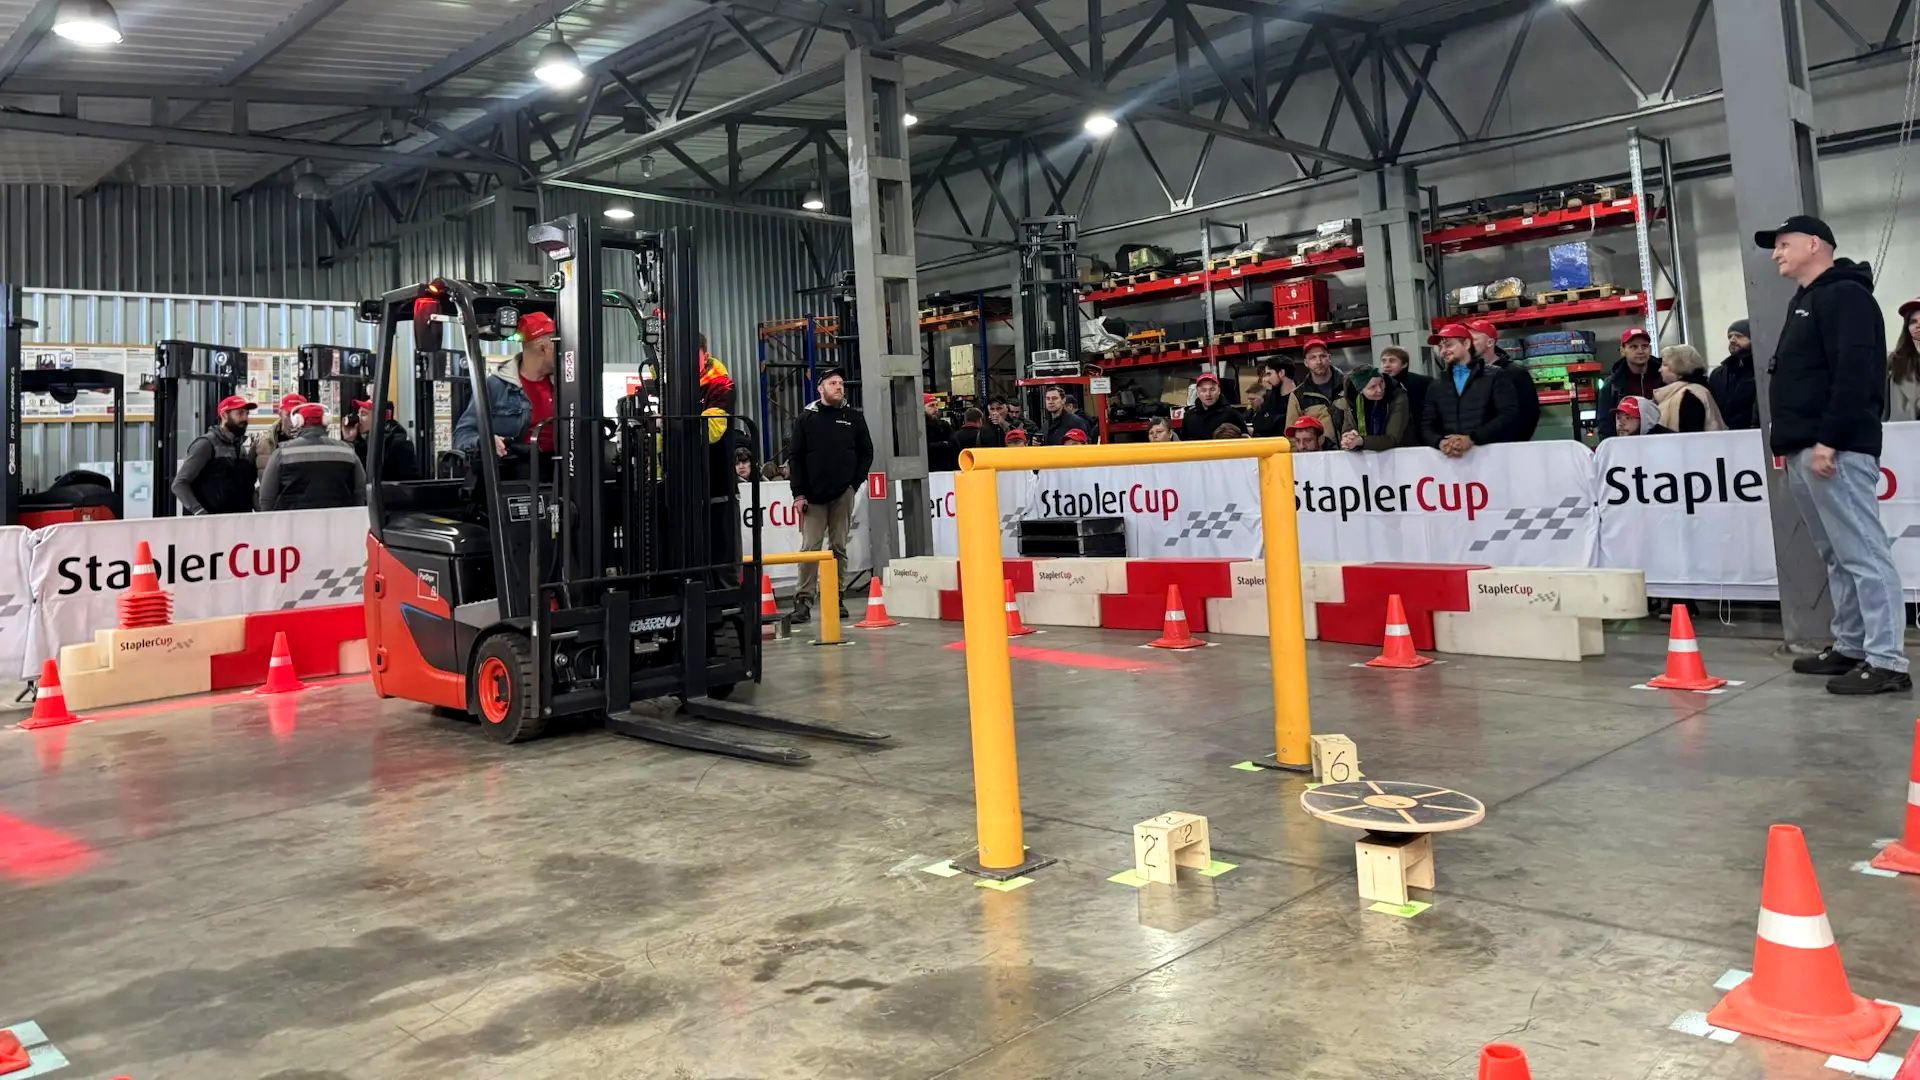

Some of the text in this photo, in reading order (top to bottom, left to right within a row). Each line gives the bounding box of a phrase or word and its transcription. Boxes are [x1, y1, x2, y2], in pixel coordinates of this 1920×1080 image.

[1041, 482, 1179, 521] StaplerCup
[58, 542, 301, 595] StalerCup
[1038, 570, 1072, 581] StaplerCup
[1236, 575, 1267, 587] Stapler
[1477, 583, 1533, 596] StaplerCup
[120, 636, 173, 652] StaplerCup
[1330, 750, 1350, 783] 6
[1143, 833, 1157, 868] 2
